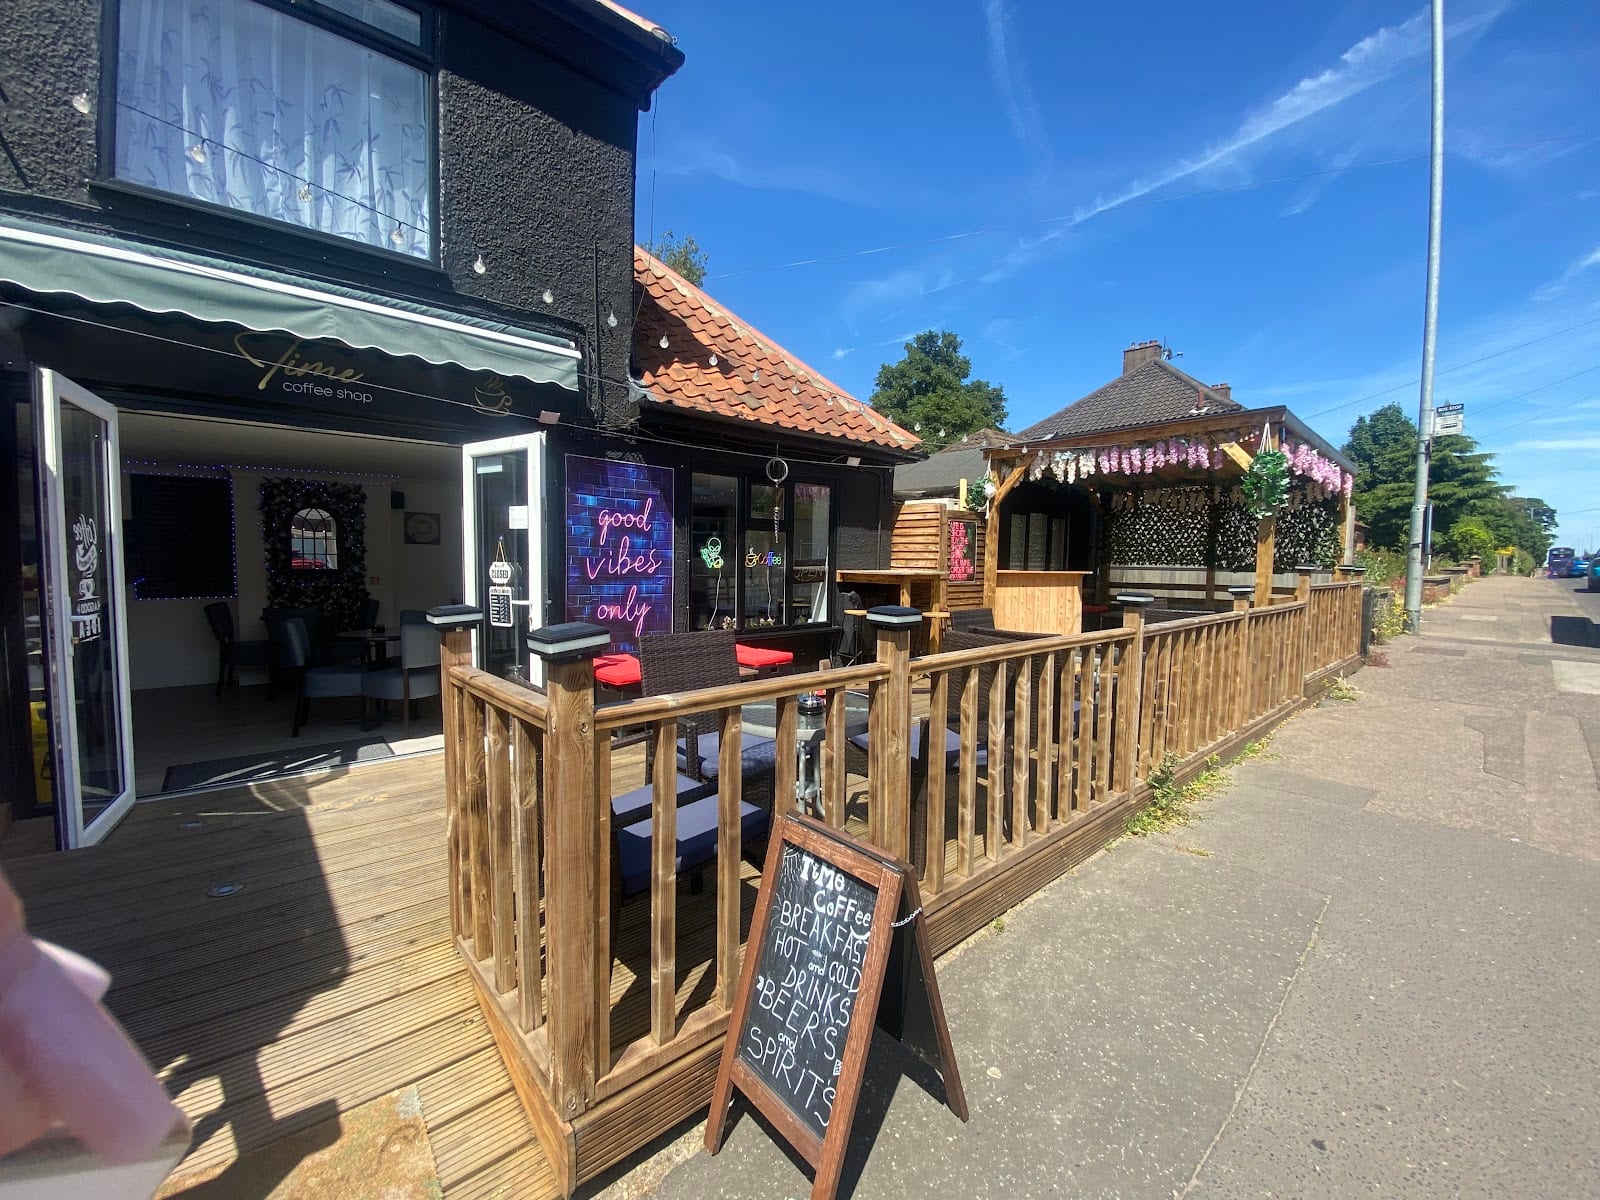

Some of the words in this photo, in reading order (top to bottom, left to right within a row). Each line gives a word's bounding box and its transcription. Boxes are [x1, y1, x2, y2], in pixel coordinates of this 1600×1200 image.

[234, 331, 364, 390] Time
[282, 382, 333, 397] coffee
[336, 388, 373, 404] shop
[598, 497, 652, 546] good
[491, 569, 509, 579] CLOSED
[586, 535, 662, 580] vibes
[757, 551, 782, 567] Coffee
[597, 585, 651, 637] only
[774, 930, 809, 963] HOT
[808, 954, 828, 977] and
[829, 960, 862, 993] COLD
[781, 964, 851, 1027] DRINKS
[777, 1032, 798, 1054] and
